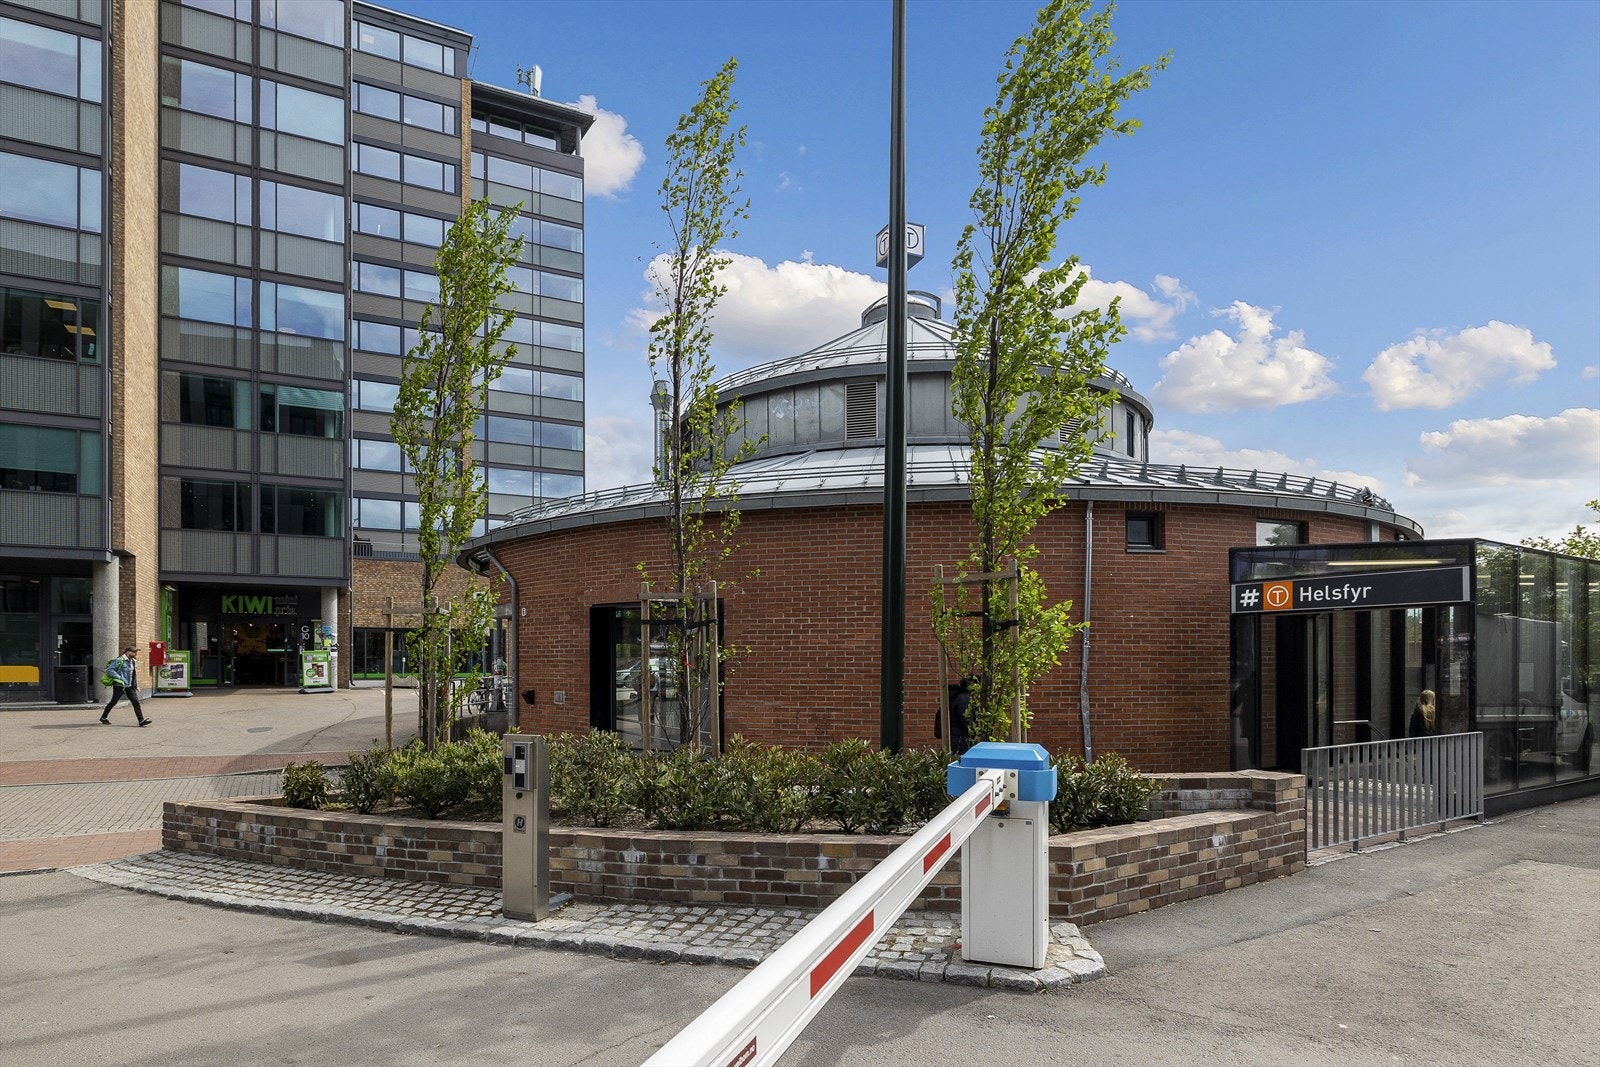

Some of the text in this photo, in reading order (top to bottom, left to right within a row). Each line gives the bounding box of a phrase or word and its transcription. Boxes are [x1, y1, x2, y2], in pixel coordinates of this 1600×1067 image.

[1299, 583, 1372, 603] Helsfyr
[221, 594, 273, 614] KIWI
[301, 625, 310, 633] G
[301, 632, 310, 640] 10
